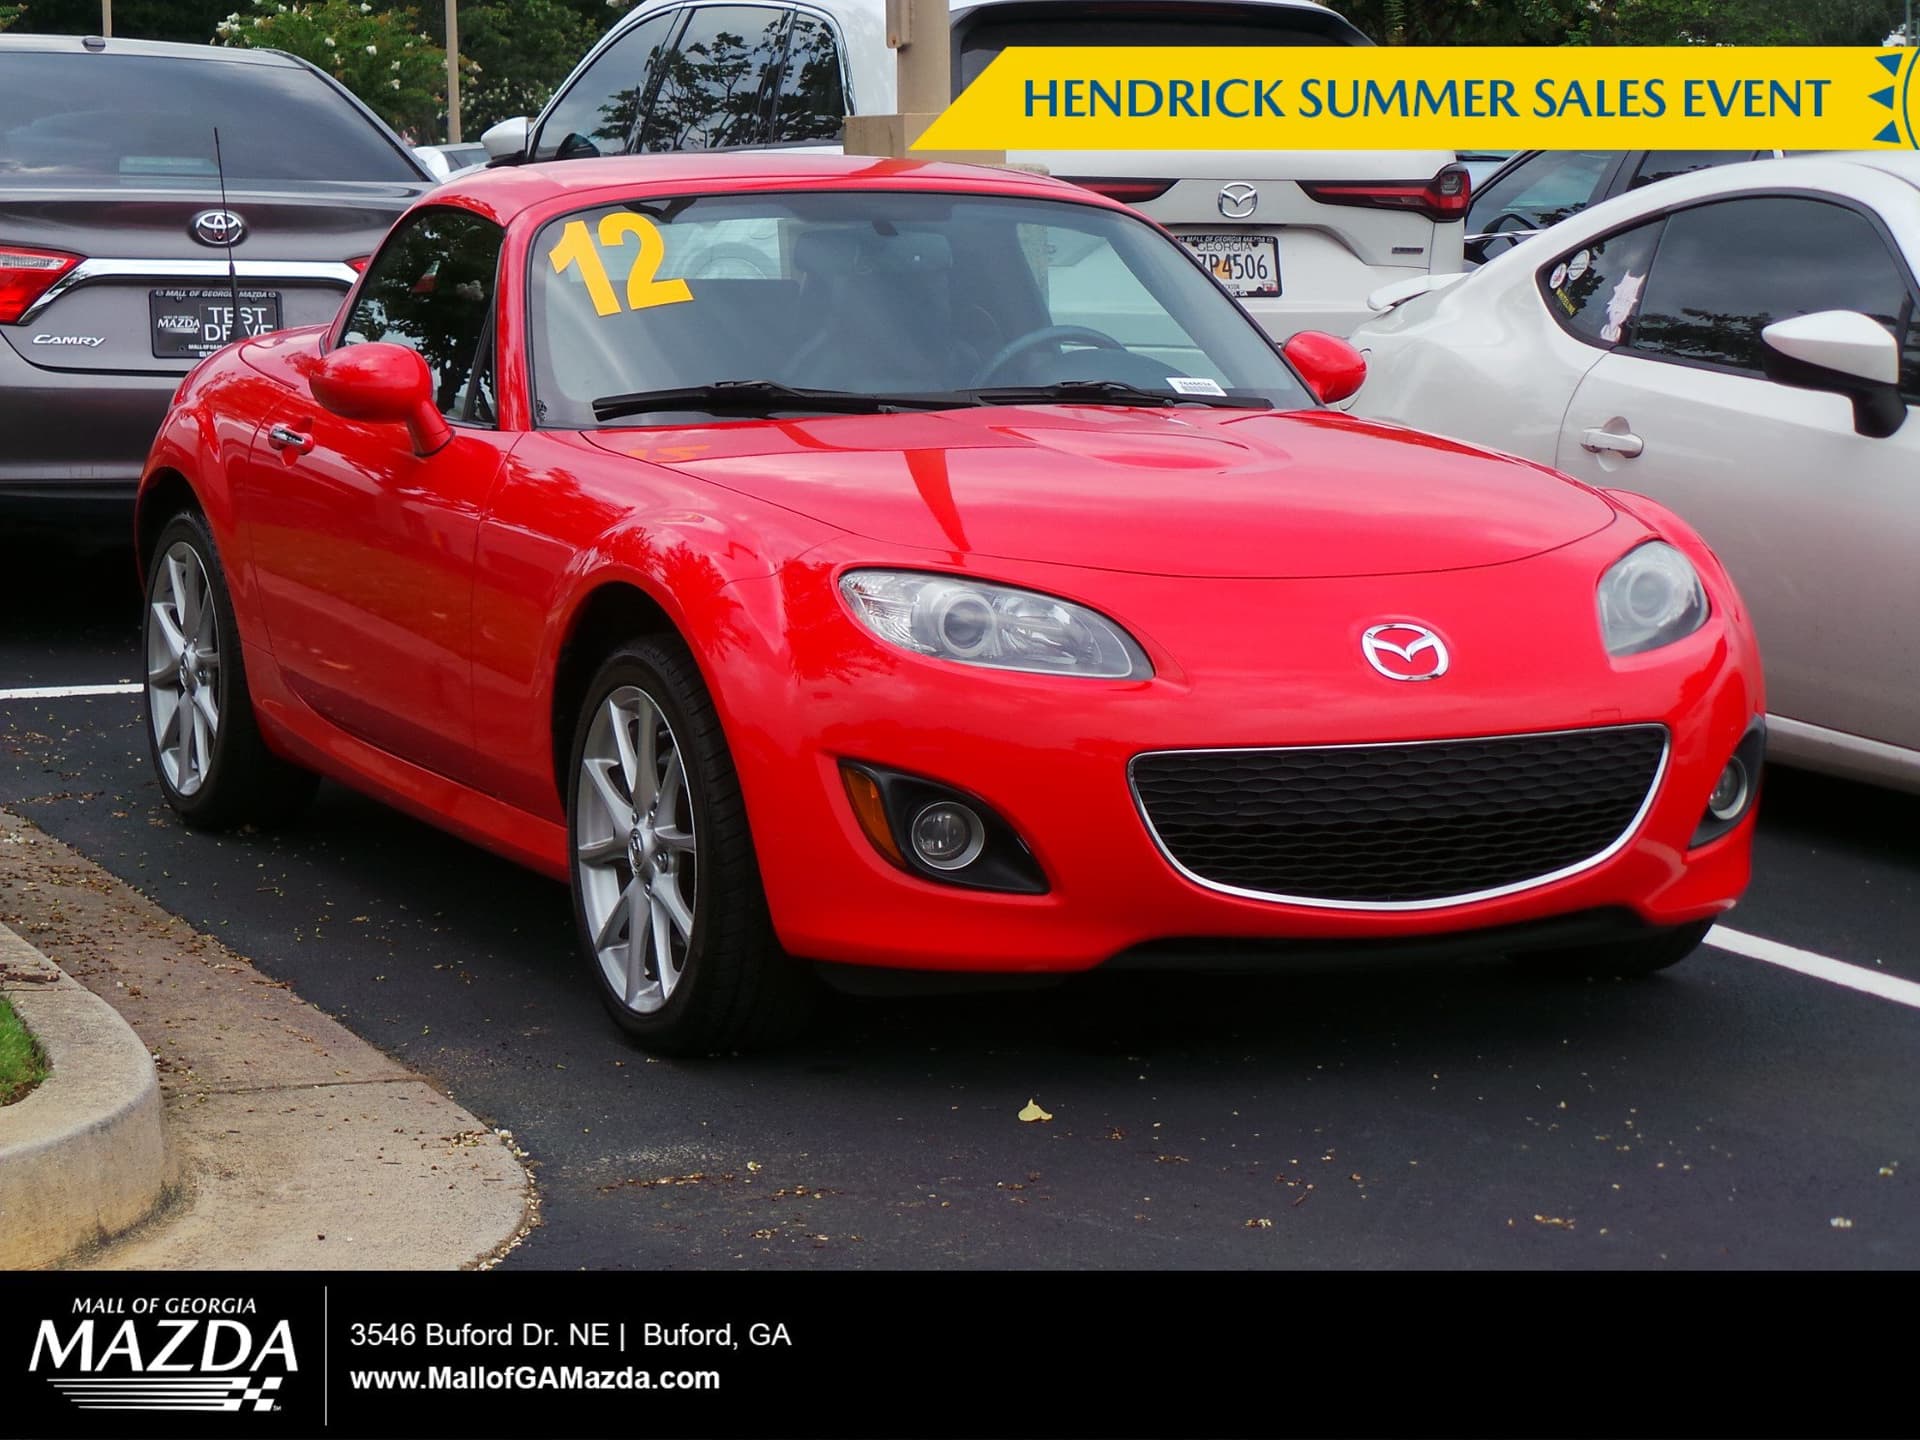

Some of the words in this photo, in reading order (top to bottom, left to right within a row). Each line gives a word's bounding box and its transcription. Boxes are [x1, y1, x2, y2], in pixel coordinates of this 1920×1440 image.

[1196, 241, 1253, 252] GEORGIA
[549, 212, 695, 317] 12
[201, 290, 233, 298] GEORGI
[207, 306, 268, 325] TEST
[157, 318, 201, 329] MAZDA
[204, 324, 274, 341] DRVE
[32, 334, 106, 347] CAMRY
